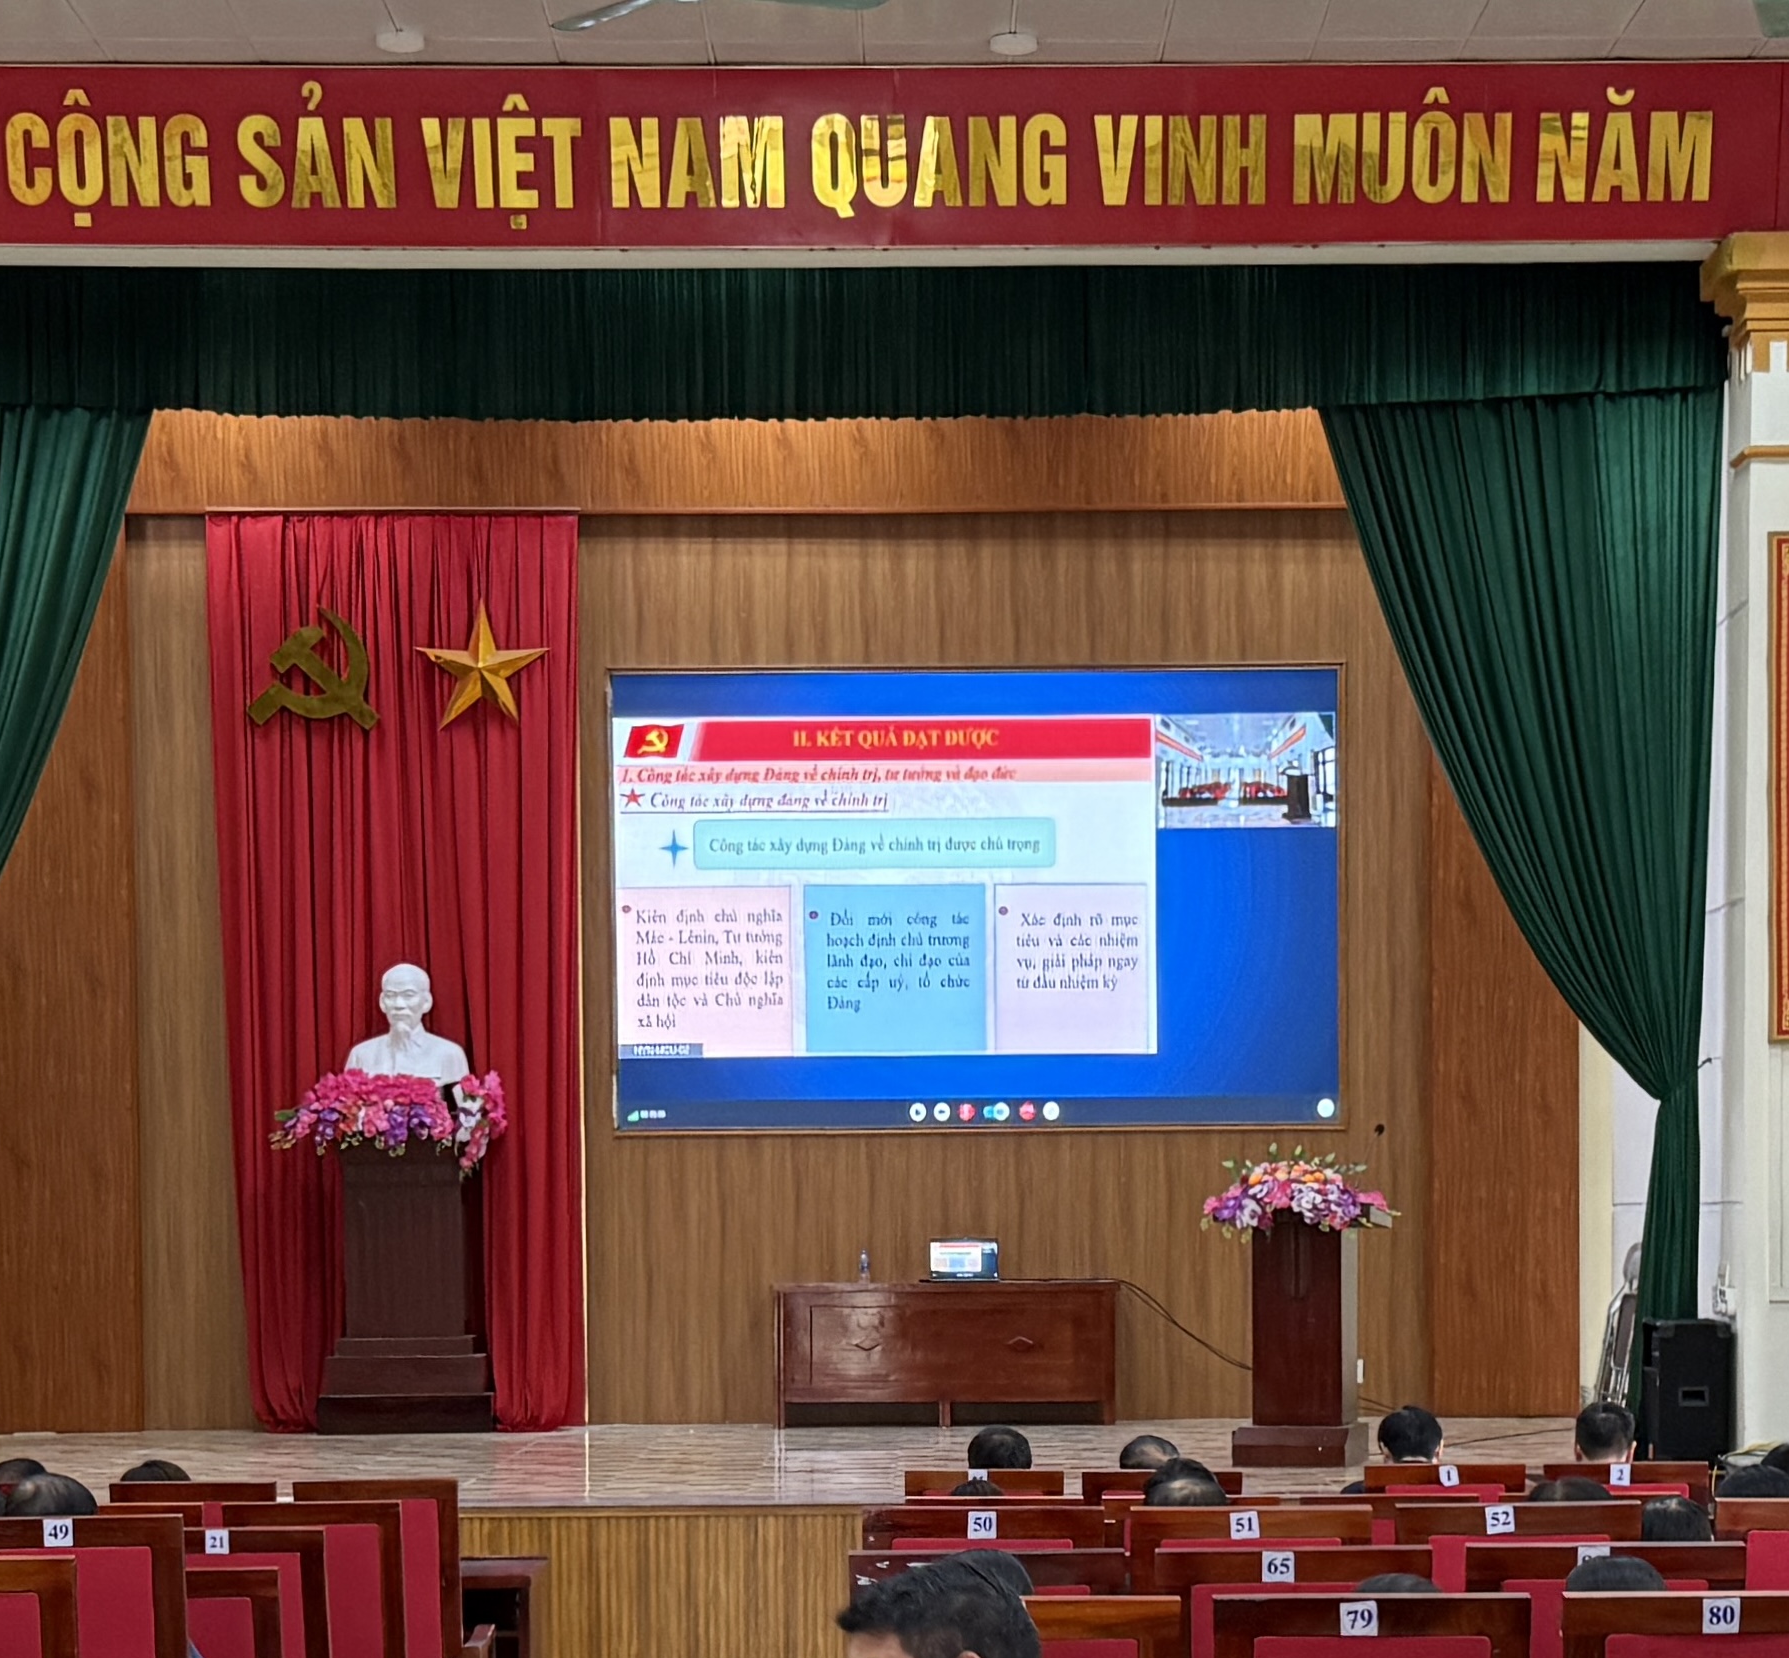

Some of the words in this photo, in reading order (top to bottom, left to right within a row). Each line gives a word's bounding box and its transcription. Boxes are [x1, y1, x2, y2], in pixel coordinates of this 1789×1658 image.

[5, 88, 211, 228] CỘNG
[236, 80, 397, 209] SẢN
[420, 93, 582, 230] VIỆT
[609, 115, 786, 209] NAM
[810, 112, 1067, 219] QUANG
[1093, 114, 1267, 206] VINH
[1293, 86, 1513, 204] MUÔN
[1536, 86, 1713, 203] NĂM
[793, 730, 811, 747] II.
[816, 727, 854, 747] KẾT
[857, 726, 898, 750] QUẢ
[902, 729, 941, 750] ĐẠT
[944, 728, 999, 749] ĐƯỢC
[1006, 838, 1041, 854] trọng
[973, 1516, 993, 1532] 50
[1235, 1516, 1253, 1533] 51
[1490, 1511, 1511, 1527] 52
[48, 1524, 69, 1540] 49
[210, 1536, 224, 1549] 21
[1267, 1557, 1291, 1575] 65
[1346, 1608, 1374, 1630] 79
[1709, 1605, 1735, 1625] 80
